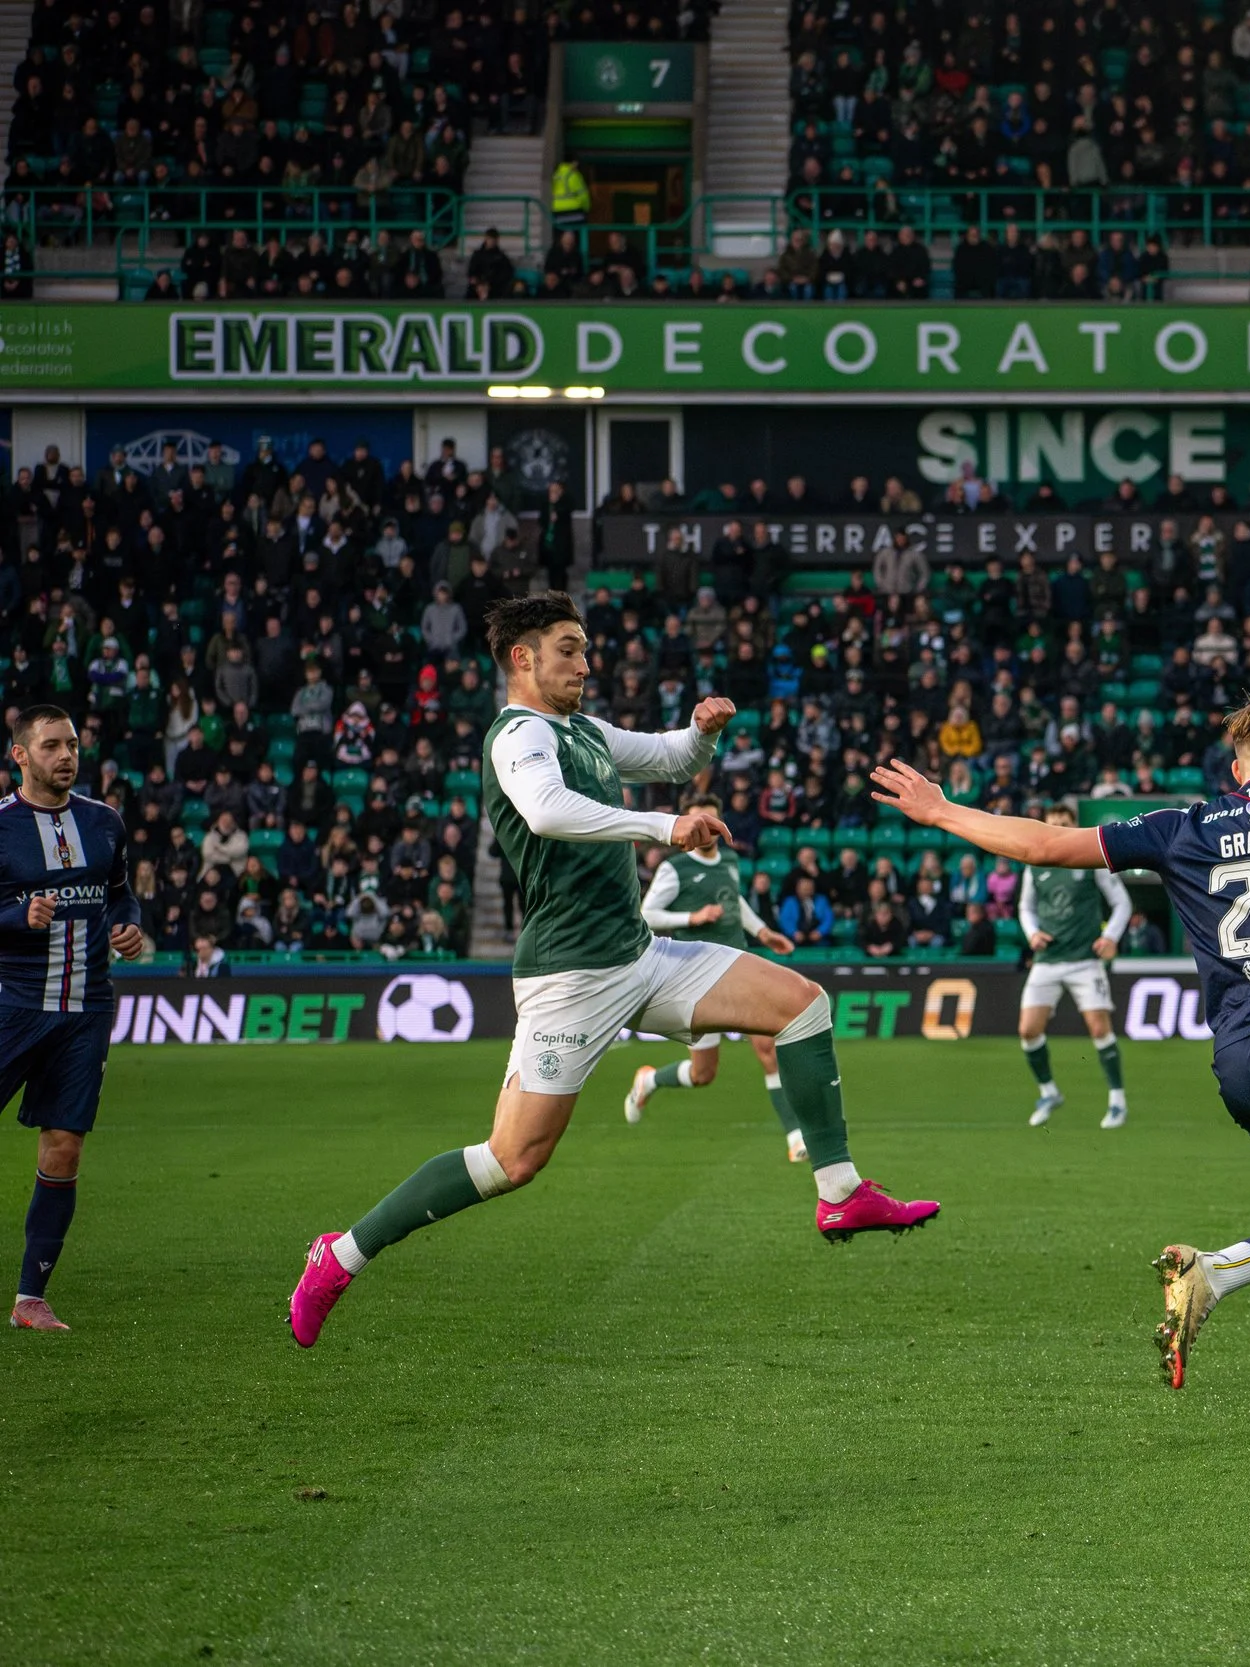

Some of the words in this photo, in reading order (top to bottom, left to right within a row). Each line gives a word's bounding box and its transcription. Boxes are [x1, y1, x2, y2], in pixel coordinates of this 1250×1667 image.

[649, 60, 671, 88] 7
[0, 319, 72, 336] cottish
[169, 313, 545, 380] EMERALD
[0, 359, 73, 376] ederation
[917, 410, 1226, 483] SINCE
[1201, 806, 1244, 824] Drain
[533, 1031, 577, 1047] Capital
